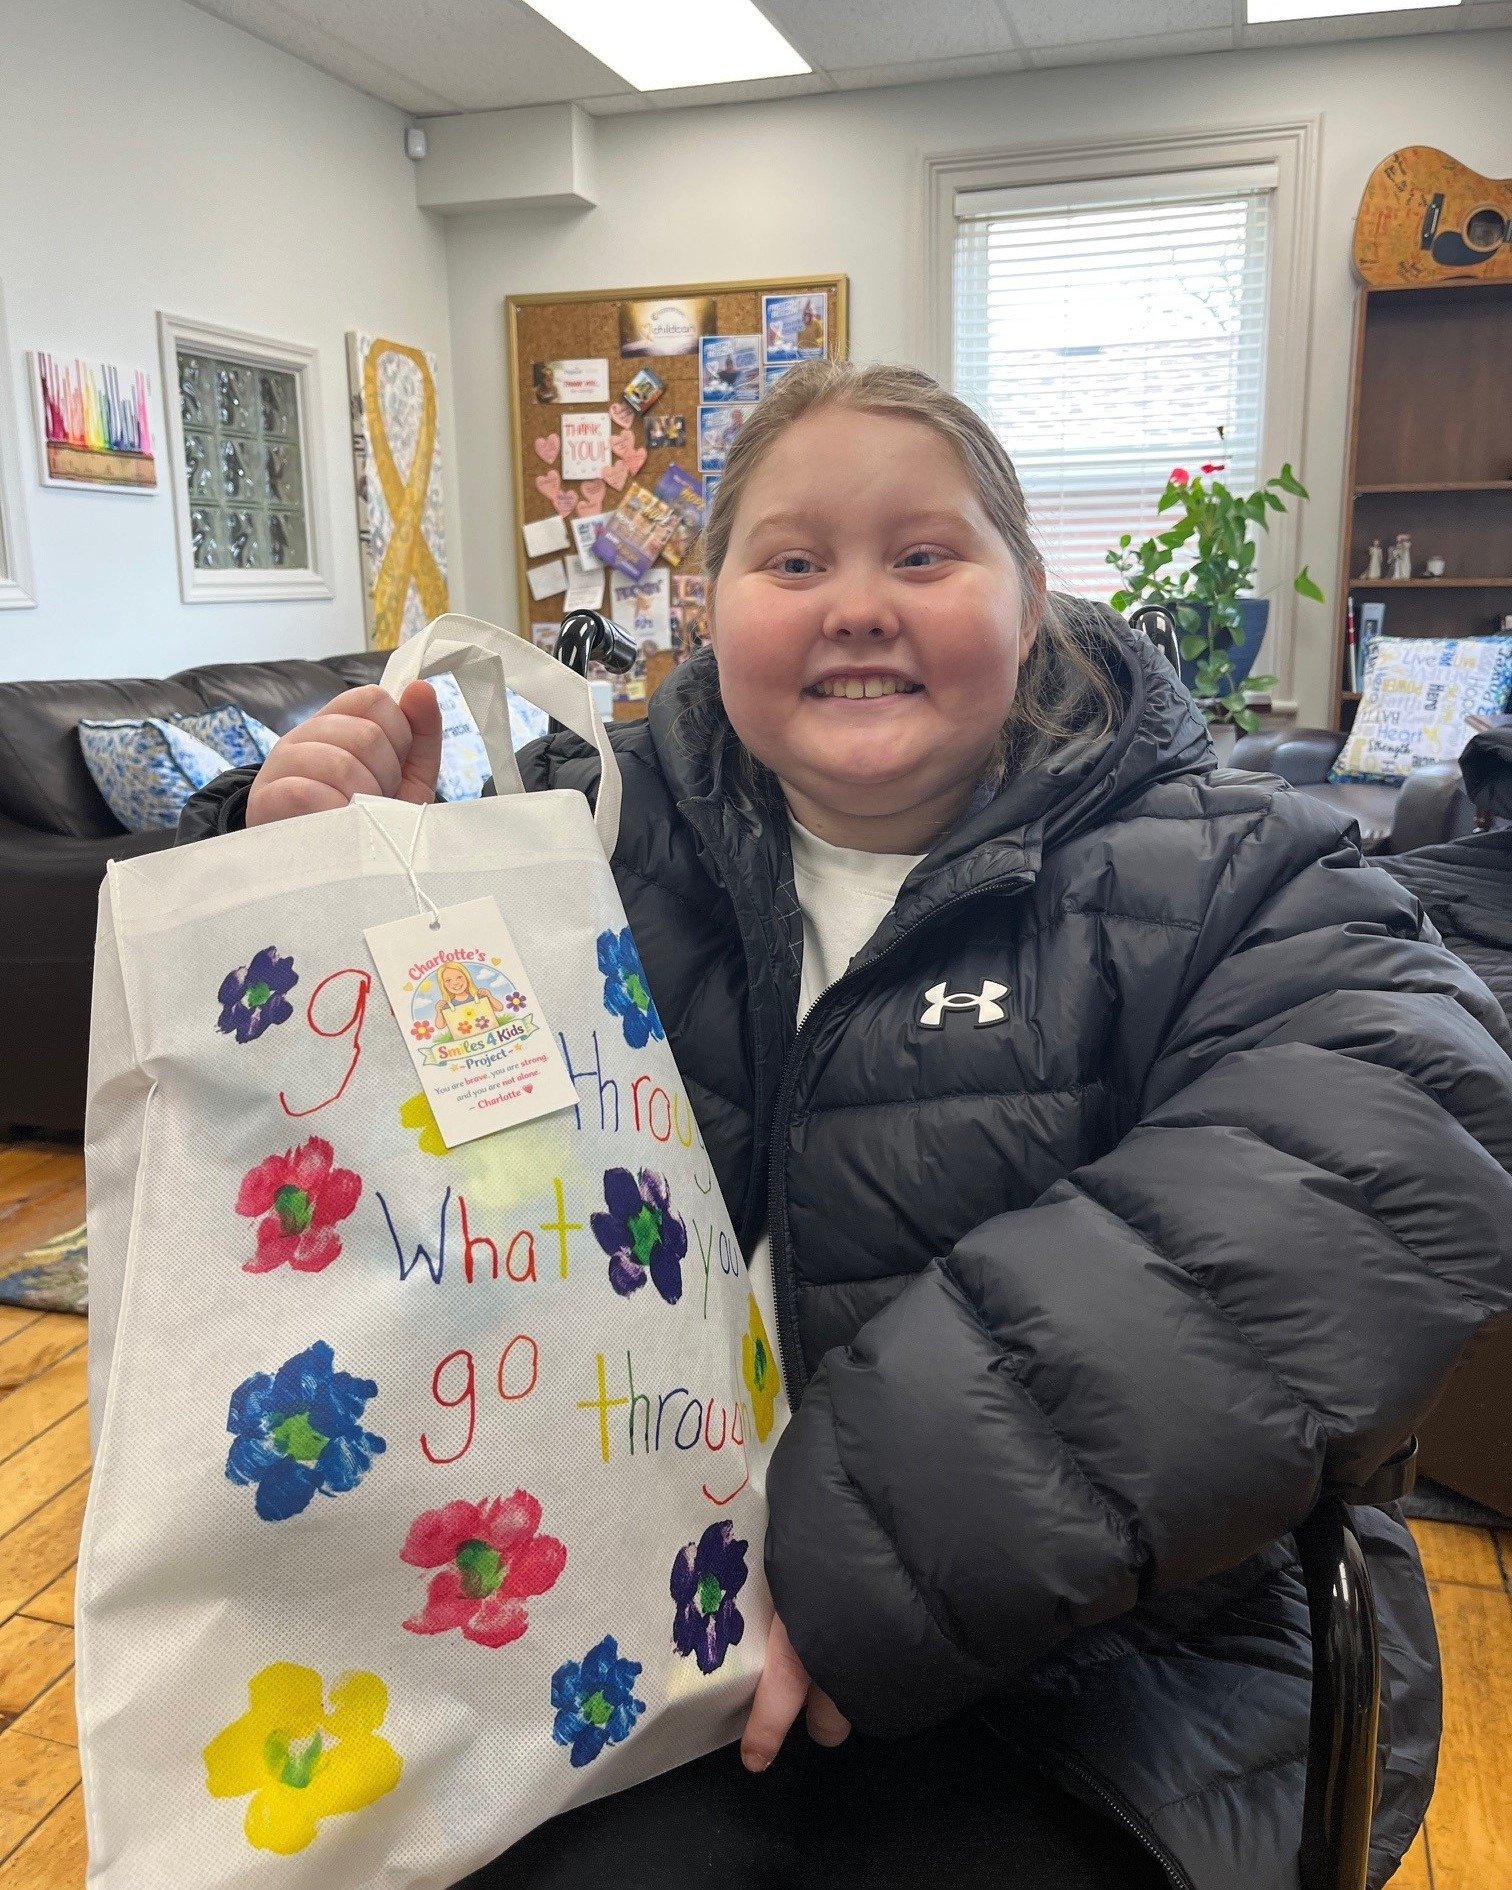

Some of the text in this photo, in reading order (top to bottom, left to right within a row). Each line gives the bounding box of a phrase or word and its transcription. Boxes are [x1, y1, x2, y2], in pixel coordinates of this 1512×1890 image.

[408, 948, 487, 982] Charlotte's
[438, 1024, 525, 1060] Smiles 4 Kids
[434, 1085, 451, 1096] You
[451, 1082, 465, 1091] are
[490, 1066, 506, 1079] you
[506, 1063, 519, 1072] are
[456, 1090, 472, 1102] and
[472, 1087, 488, 1099] you
[488, 1083, 501, 1092] are
[502, 1077, 516, 1087] not
[477, 1089, 522, 1109] Charlotte
[376, 1177, 739, 1320] What you
[420, 1334, 539, 1464] go
